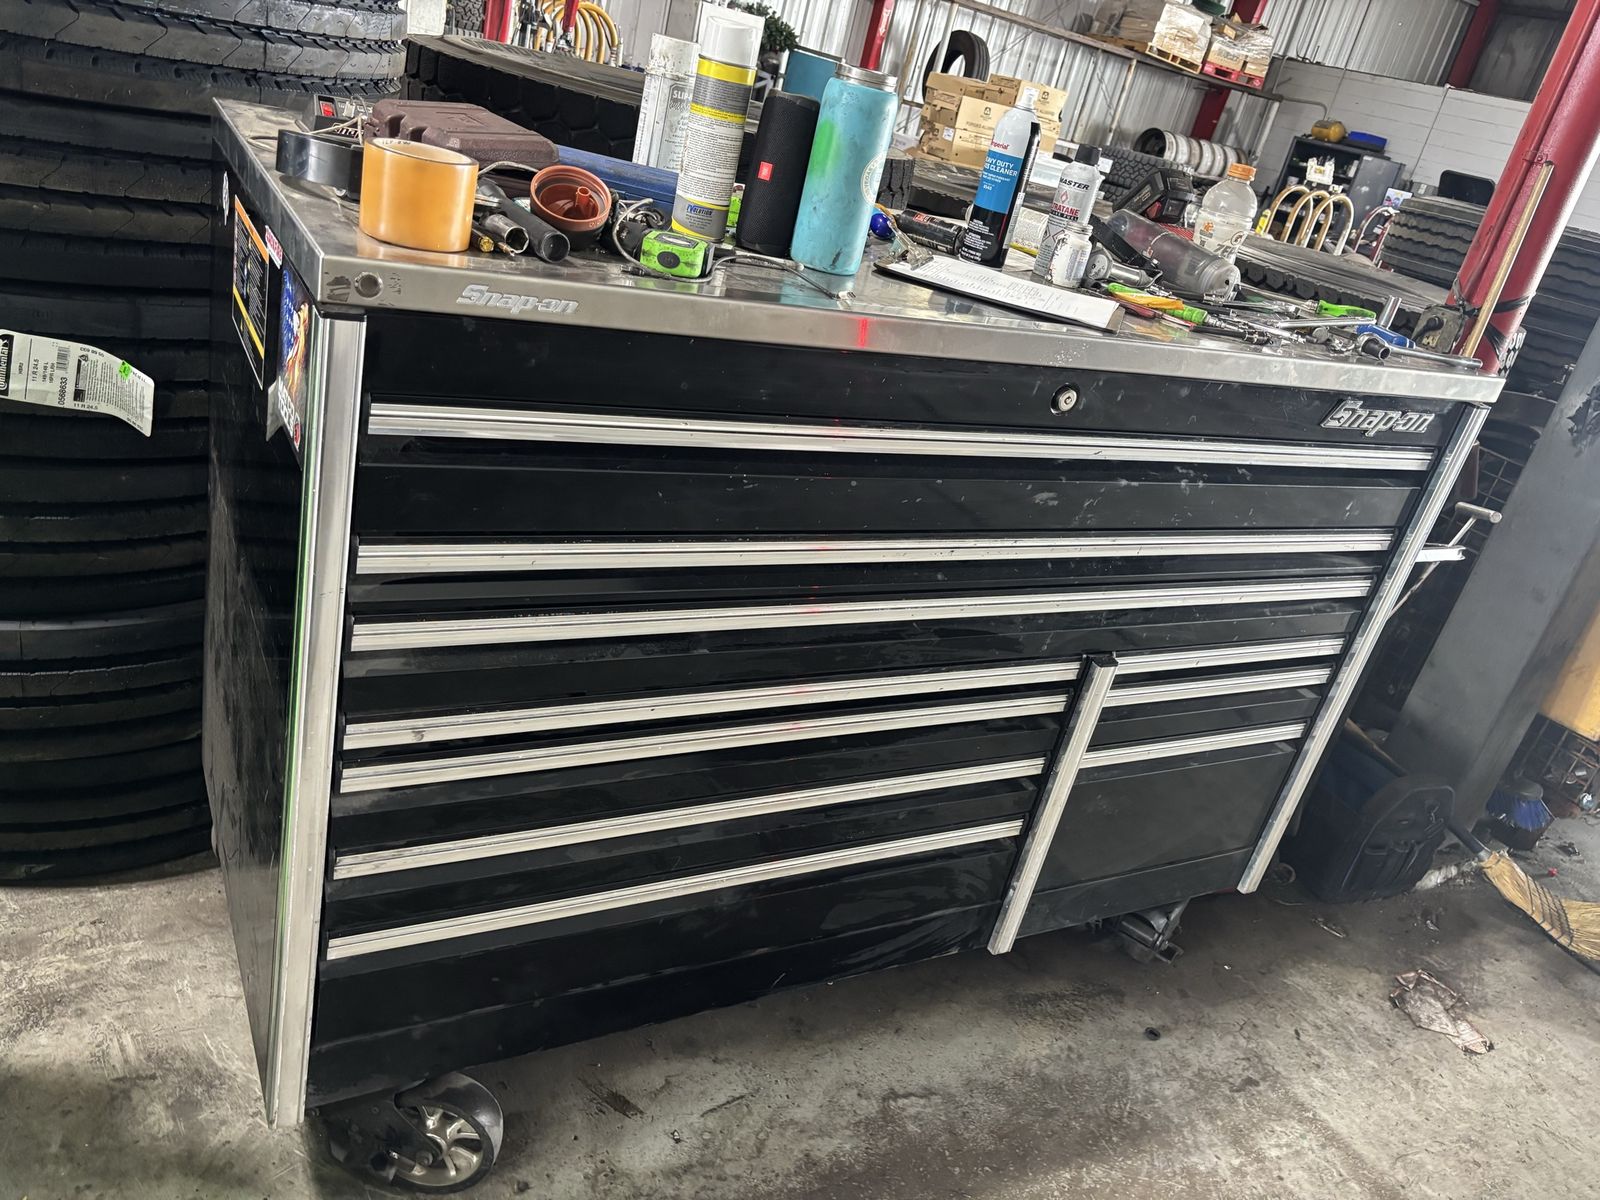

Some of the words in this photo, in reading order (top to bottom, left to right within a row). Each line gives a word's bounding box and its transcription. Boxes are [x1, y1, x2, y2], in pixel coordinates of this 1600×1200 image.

[990, 164, 1018, 177] CLEANER
[996, 159, 1014, 169] DUTY
[456, 284, 579, 315] Snap-on
[57, 376, 68, 406] 0568633
[1320, 397, 1435, 437] Snap-on
